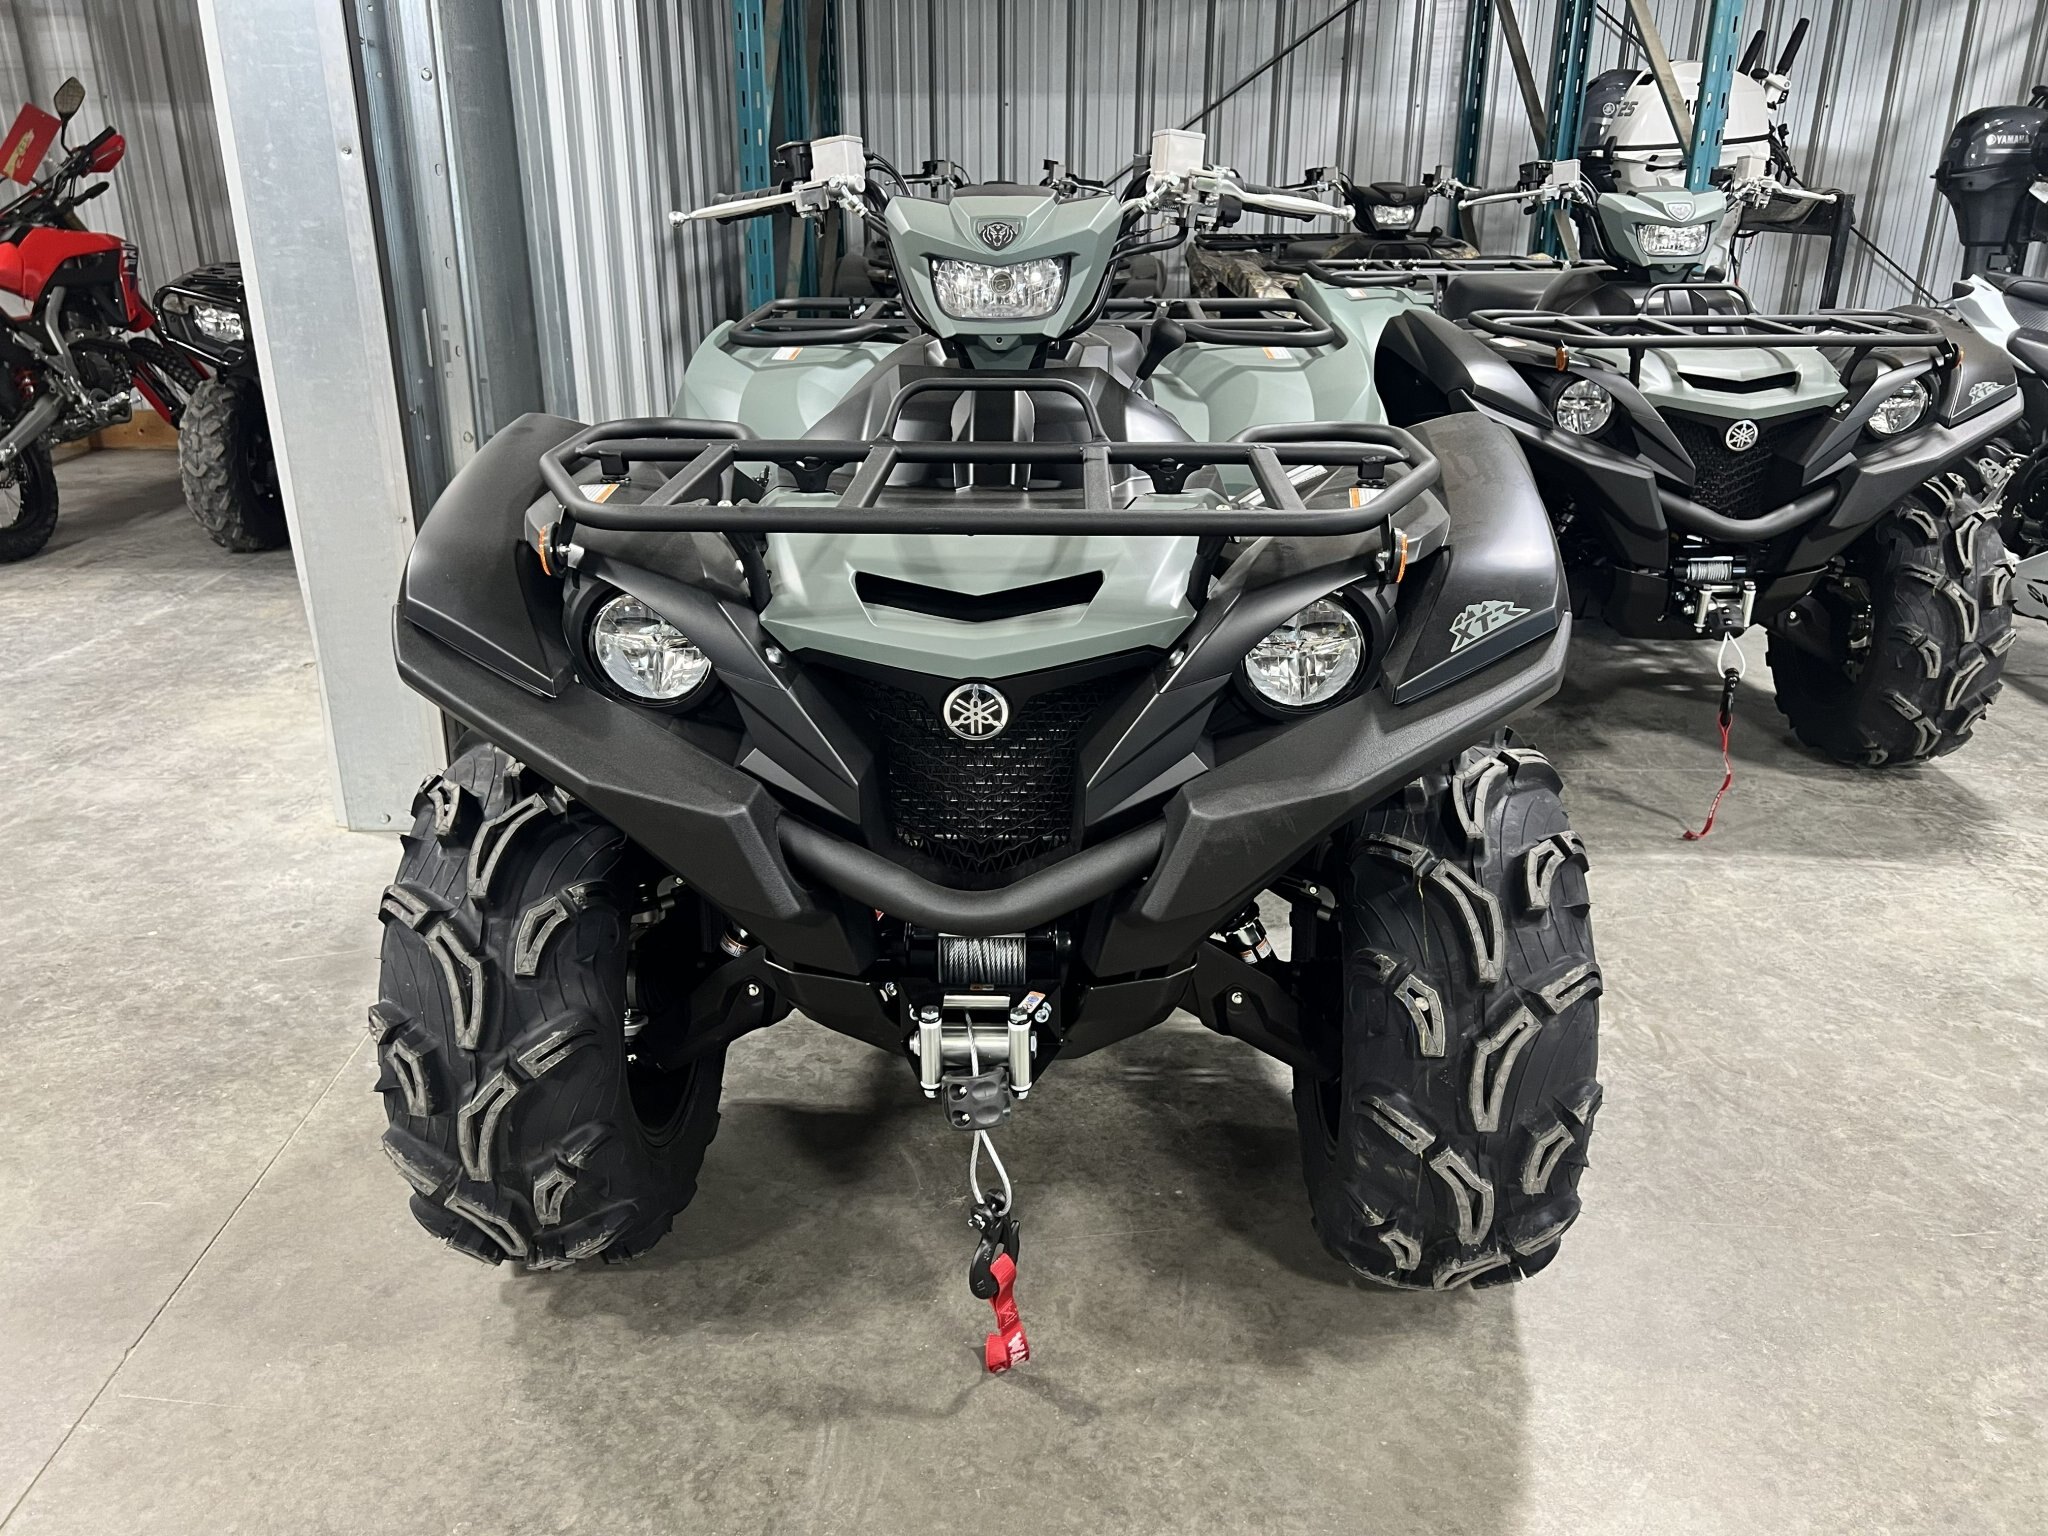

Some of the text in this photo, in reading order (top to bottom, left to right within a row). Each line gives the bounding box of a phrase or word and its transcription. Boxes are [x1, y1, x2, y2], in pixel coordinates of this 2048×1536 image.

[1617, 101, 1639, 117] 25
[1950, 138, 1962, 148] 8
[1996, 134, 2030, 145] YAMAHA
[1449, 600, 1530, 651] XT-R
